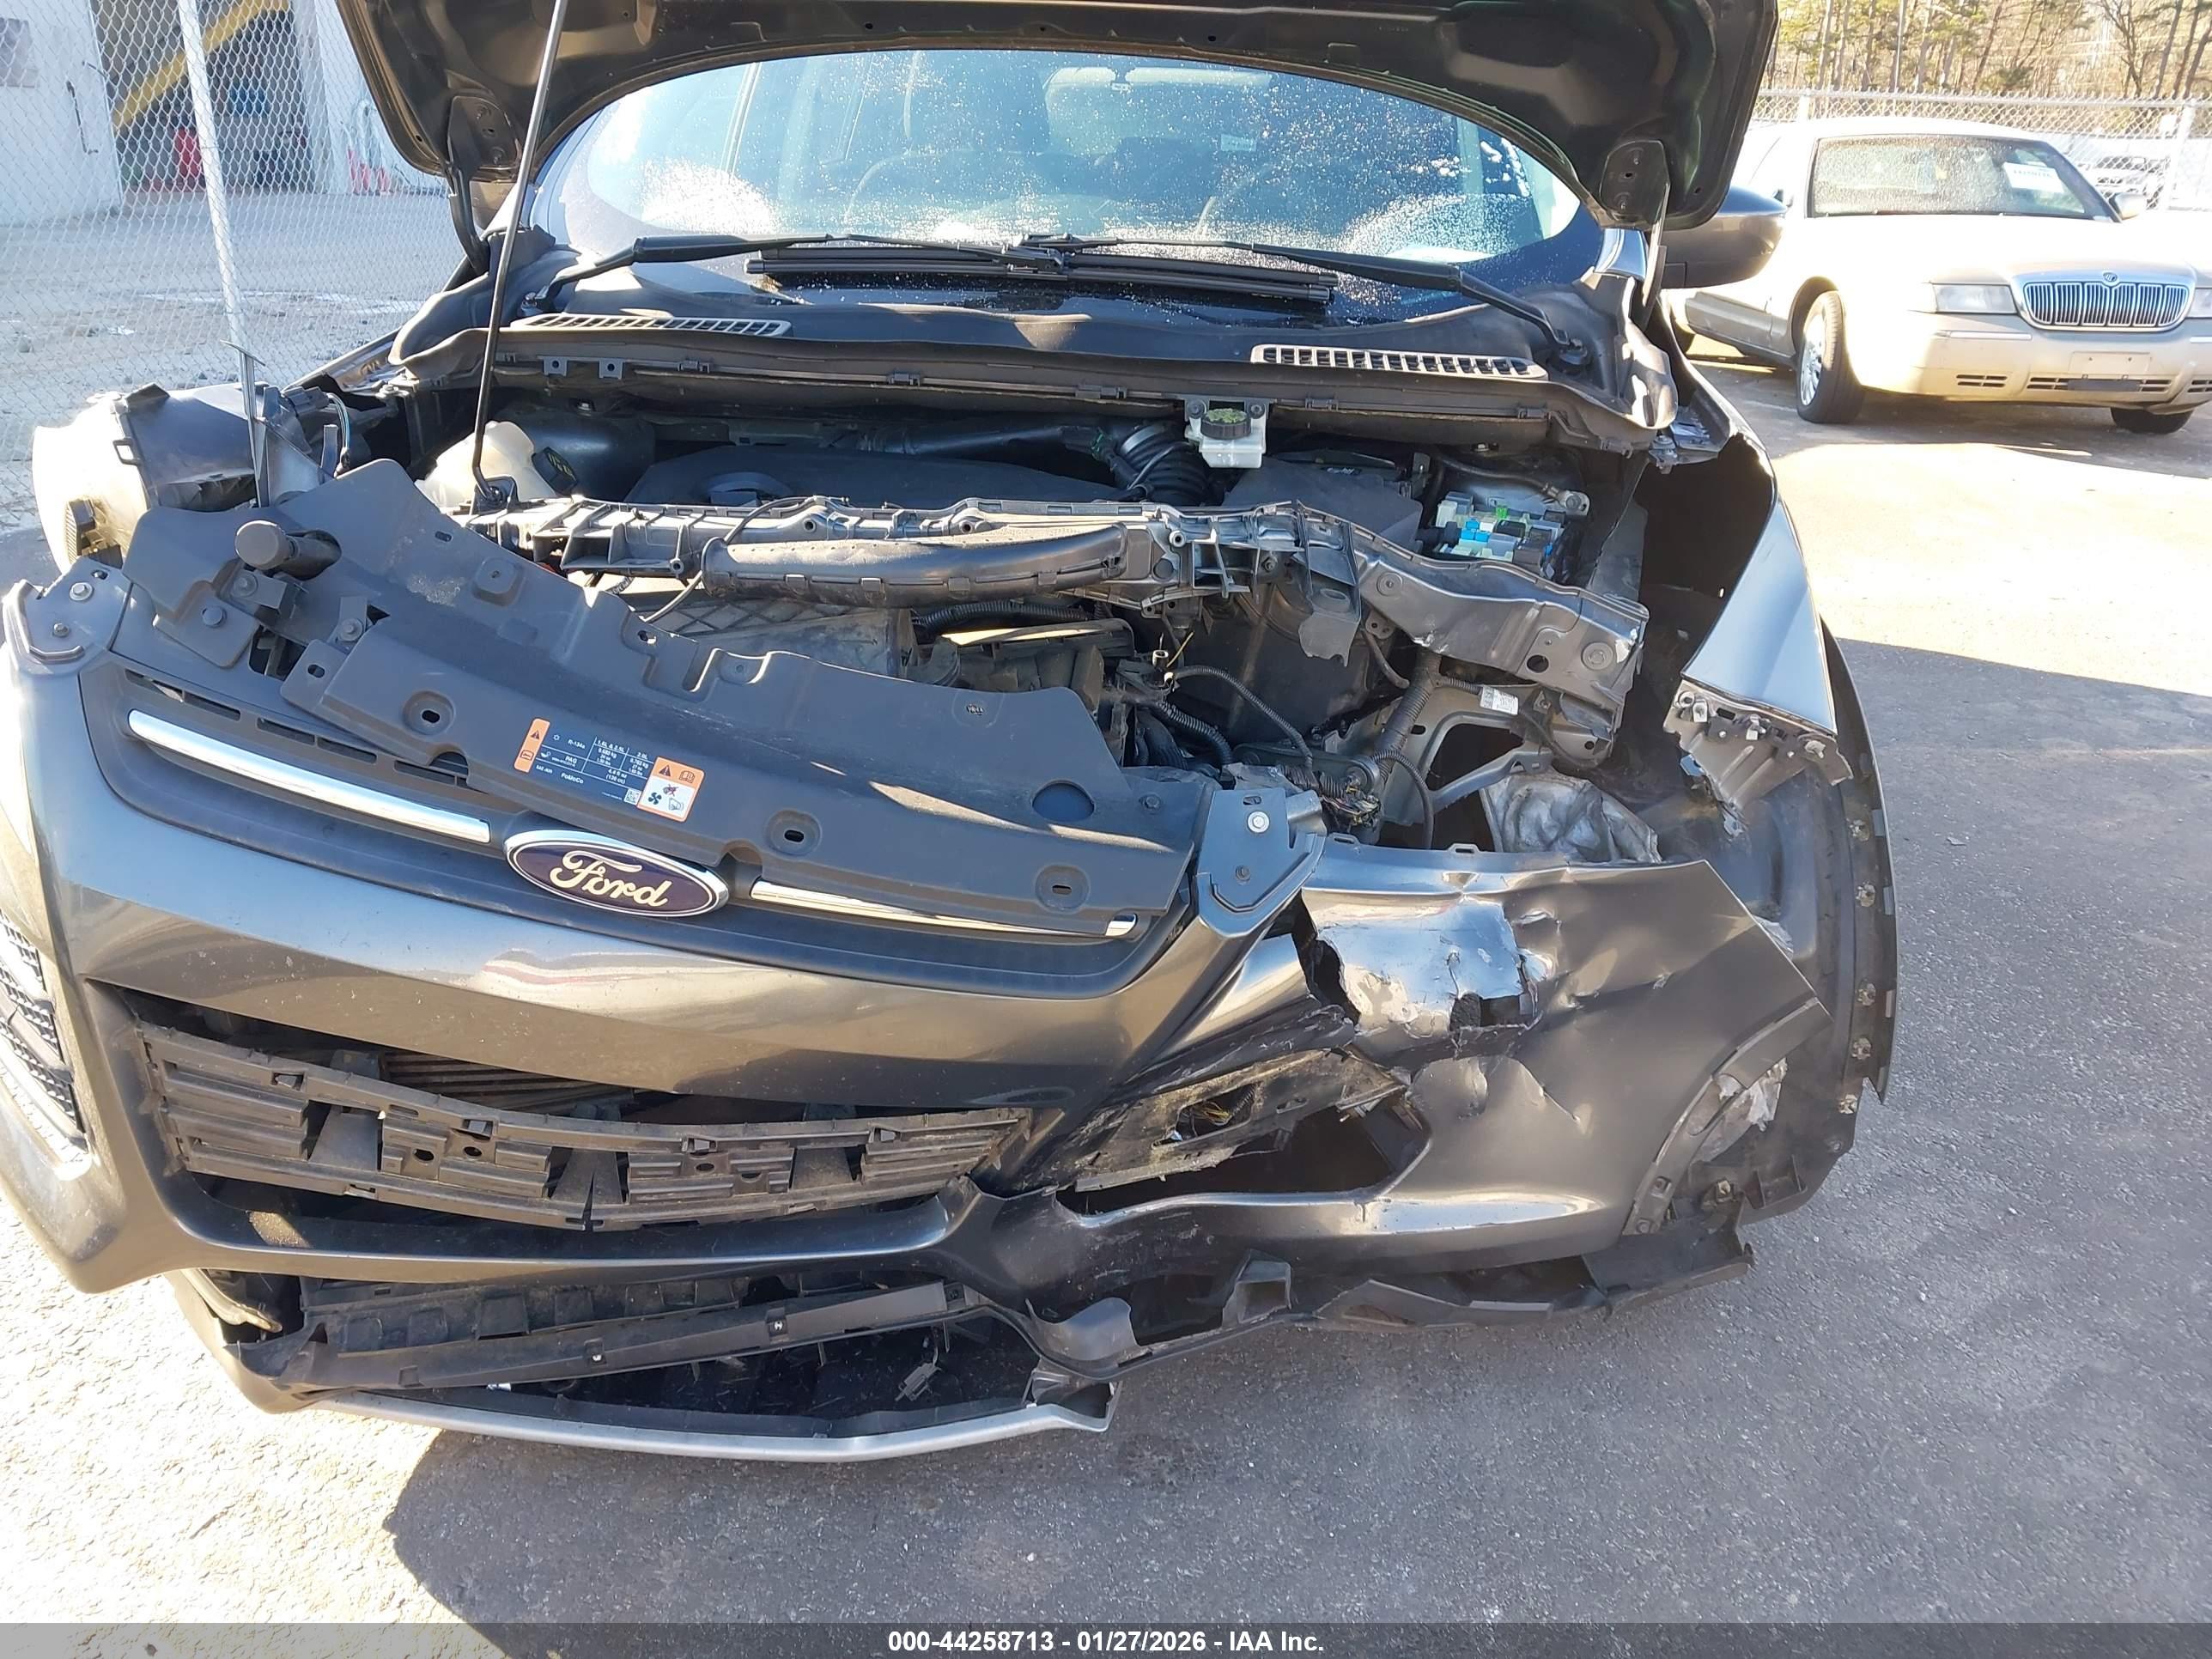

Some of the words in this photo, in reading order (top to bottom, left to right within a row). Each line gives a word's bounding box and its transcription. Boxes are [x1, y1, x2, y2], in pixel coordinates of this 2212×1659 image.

[568, 739, 586, 749] R-134a
[561, 773, 584, 784] FoMoCo
[550, 850, 672, 907] Ford
